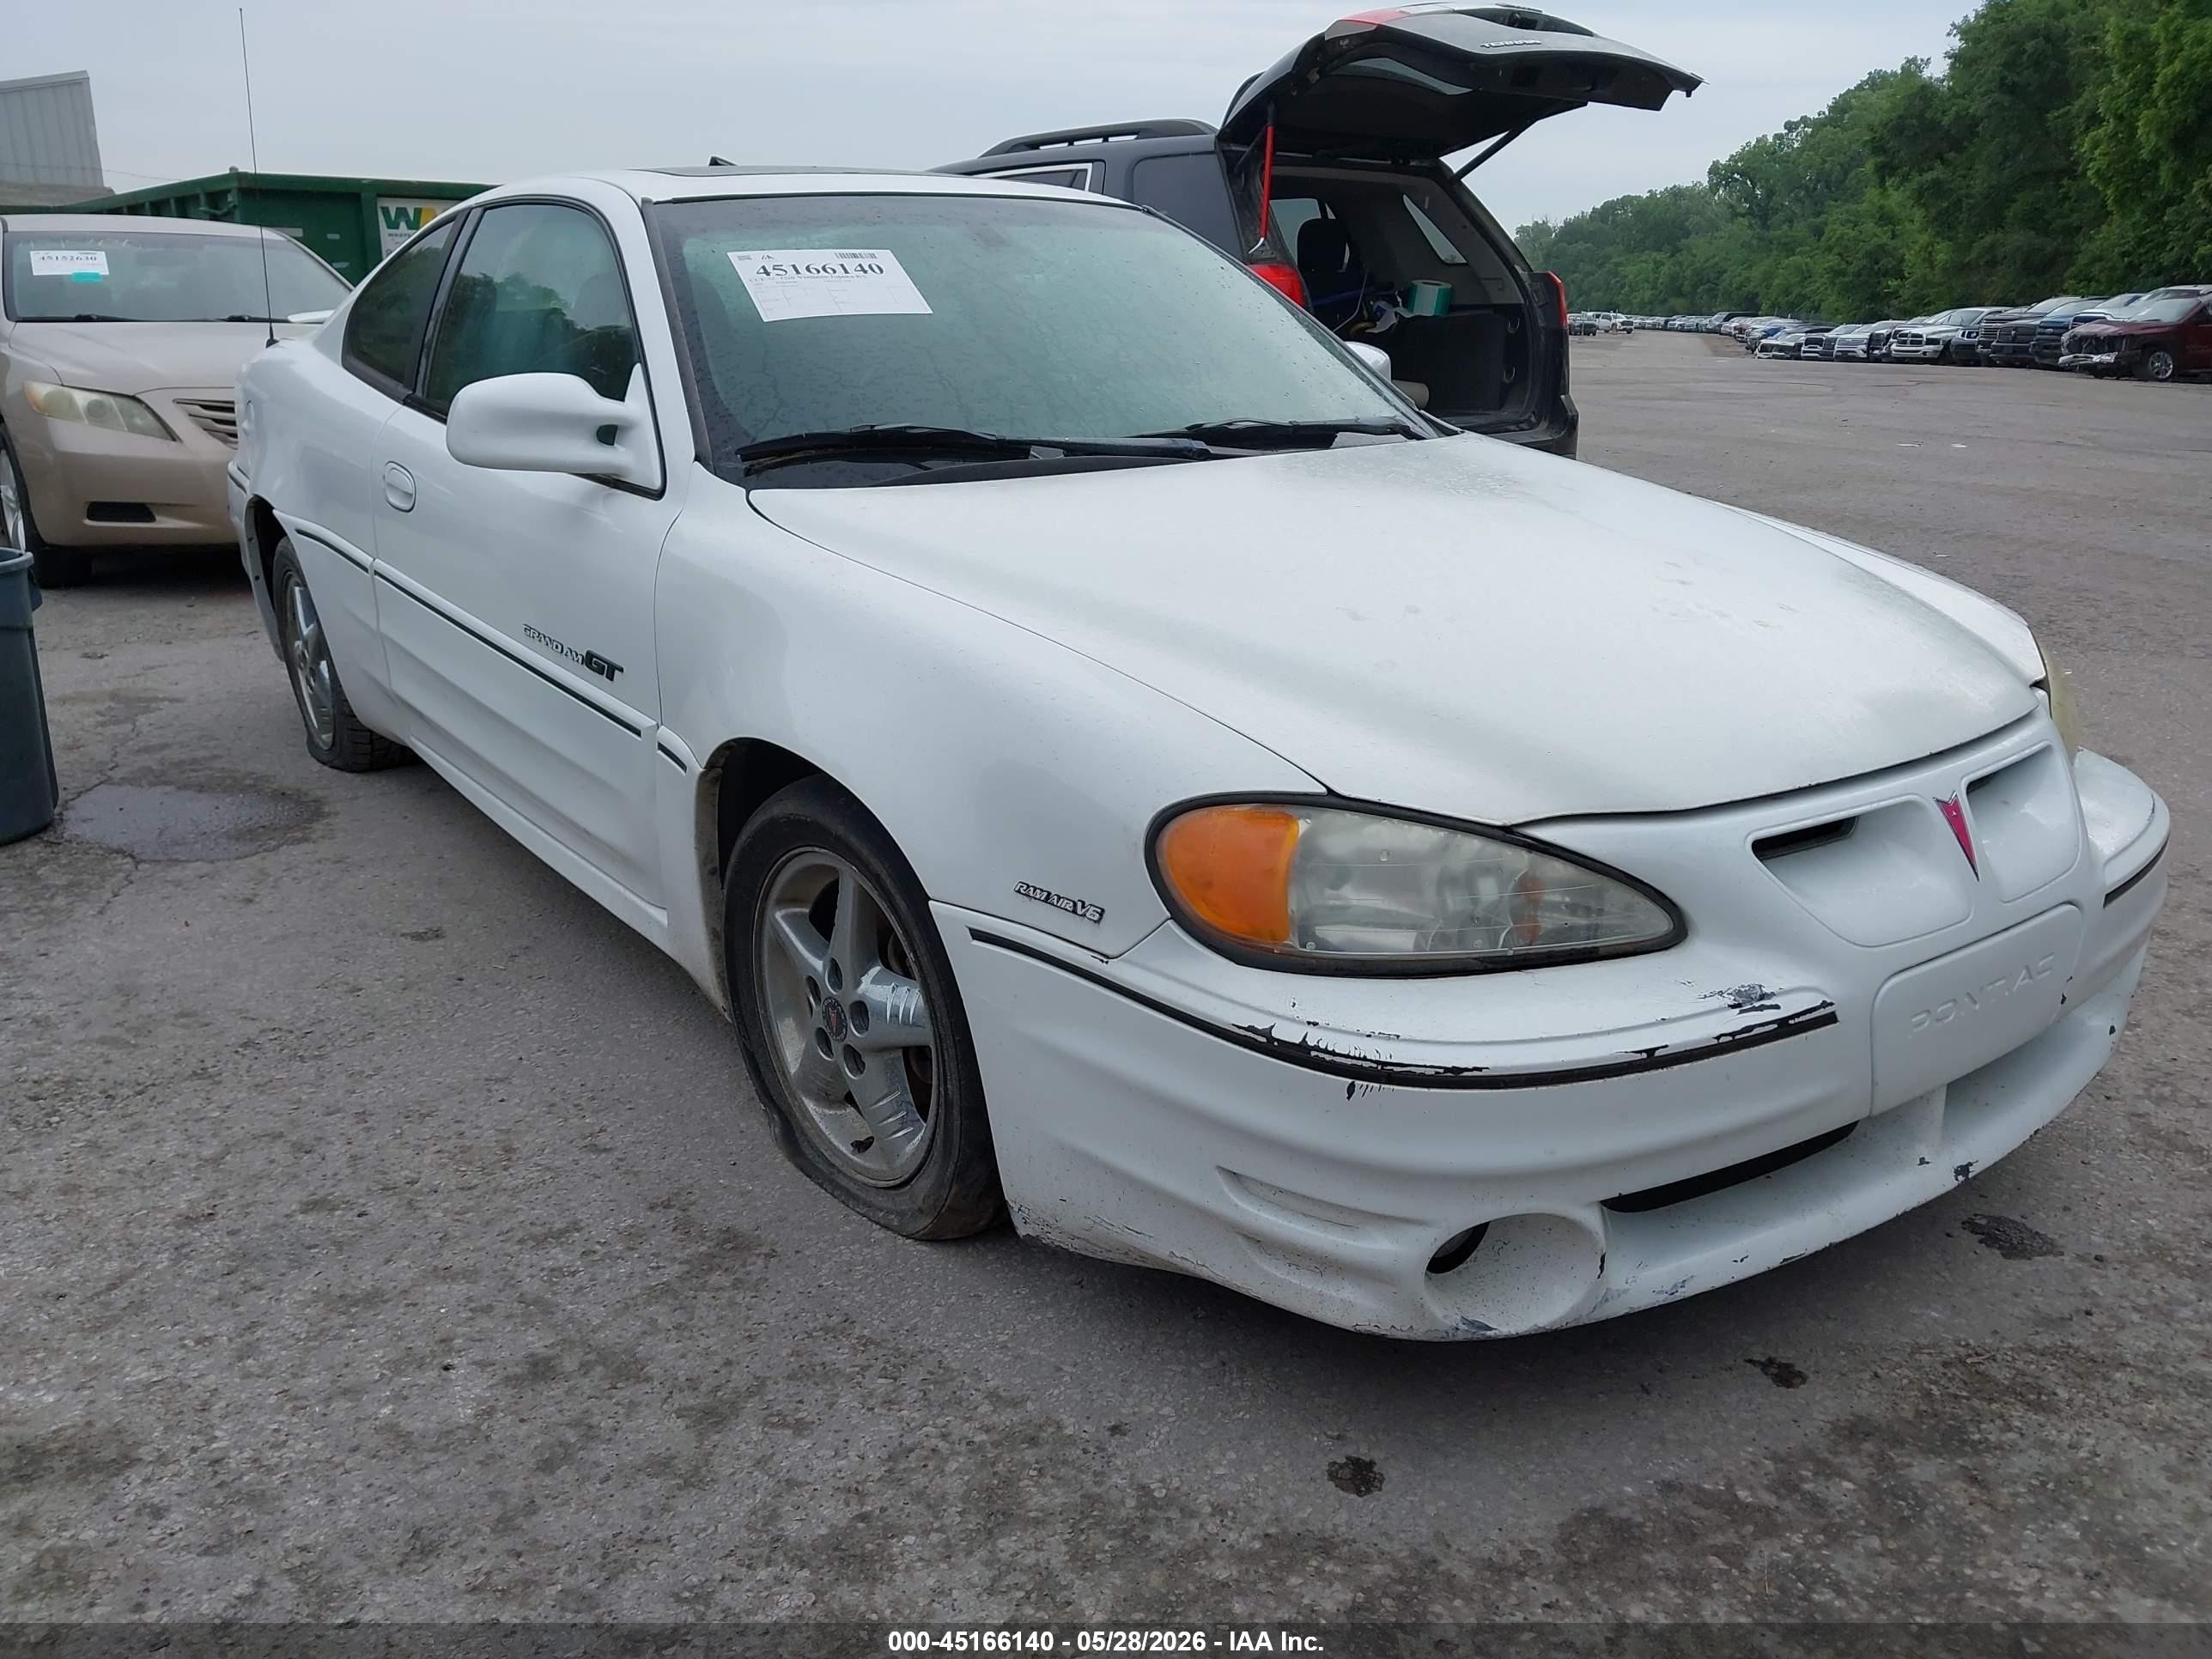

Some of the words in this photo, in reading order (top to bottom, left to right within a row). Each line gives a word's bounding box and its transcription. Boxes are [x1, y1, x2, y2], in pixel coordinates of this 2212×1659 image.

[756, 263, 884, 276] 45166140
[522, 623, 563, 654] GRAND
[563, 647, 585, 665] AM
[585, 649, 624, 682] GT
[1014, 881, 1048, 902] RAM
[1047, 893, 1077, 914] AIR
[1075, 899, 1105, 924] V6
